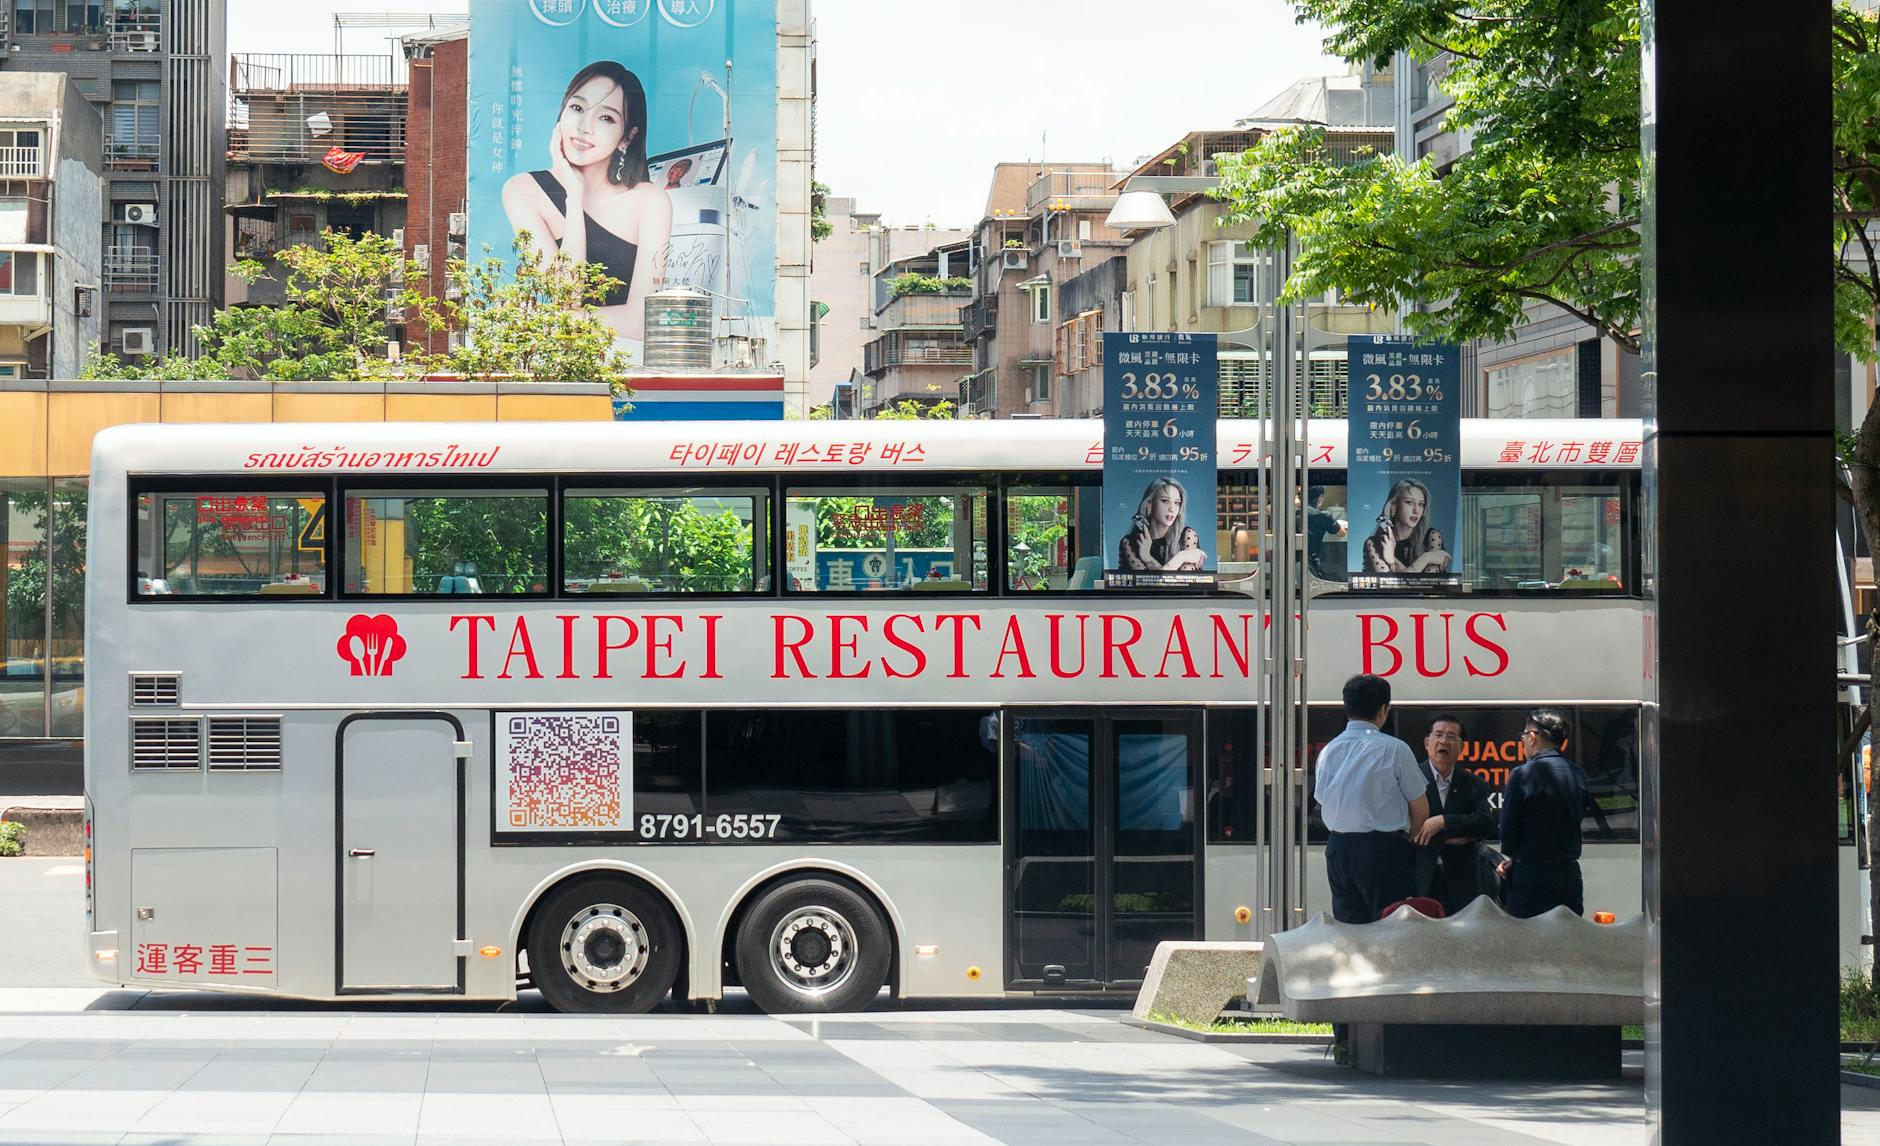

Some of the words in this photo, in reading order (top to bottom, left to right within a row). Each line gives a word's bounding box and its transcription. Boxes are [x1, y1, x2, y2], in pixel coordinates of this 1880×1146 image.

[607, 0, 637, 15] 治療
[671, 0, 701, 15] 導入
[1119, 352, 1142, 364] 微風
[1165, 352, 1200, 364] 無限卡
[1363, 353, 1386, 365] 微風
[1409, 354, 1445, 366] 無限卡
[669, 442, 767, 466] 타이페이
[774, 441, 873, 466] 레스토랑
[880, 442, 927, 466] 버스
[1498, 440, 1642, 465] 臺北市雙層
[450, 614, 723, 680] TAIPEI
[770, 613, 1310, 680] RESTAURAN
[1355, 612, 1511, 678] BUS
[639, 813, 782, 839] 8791-6557
